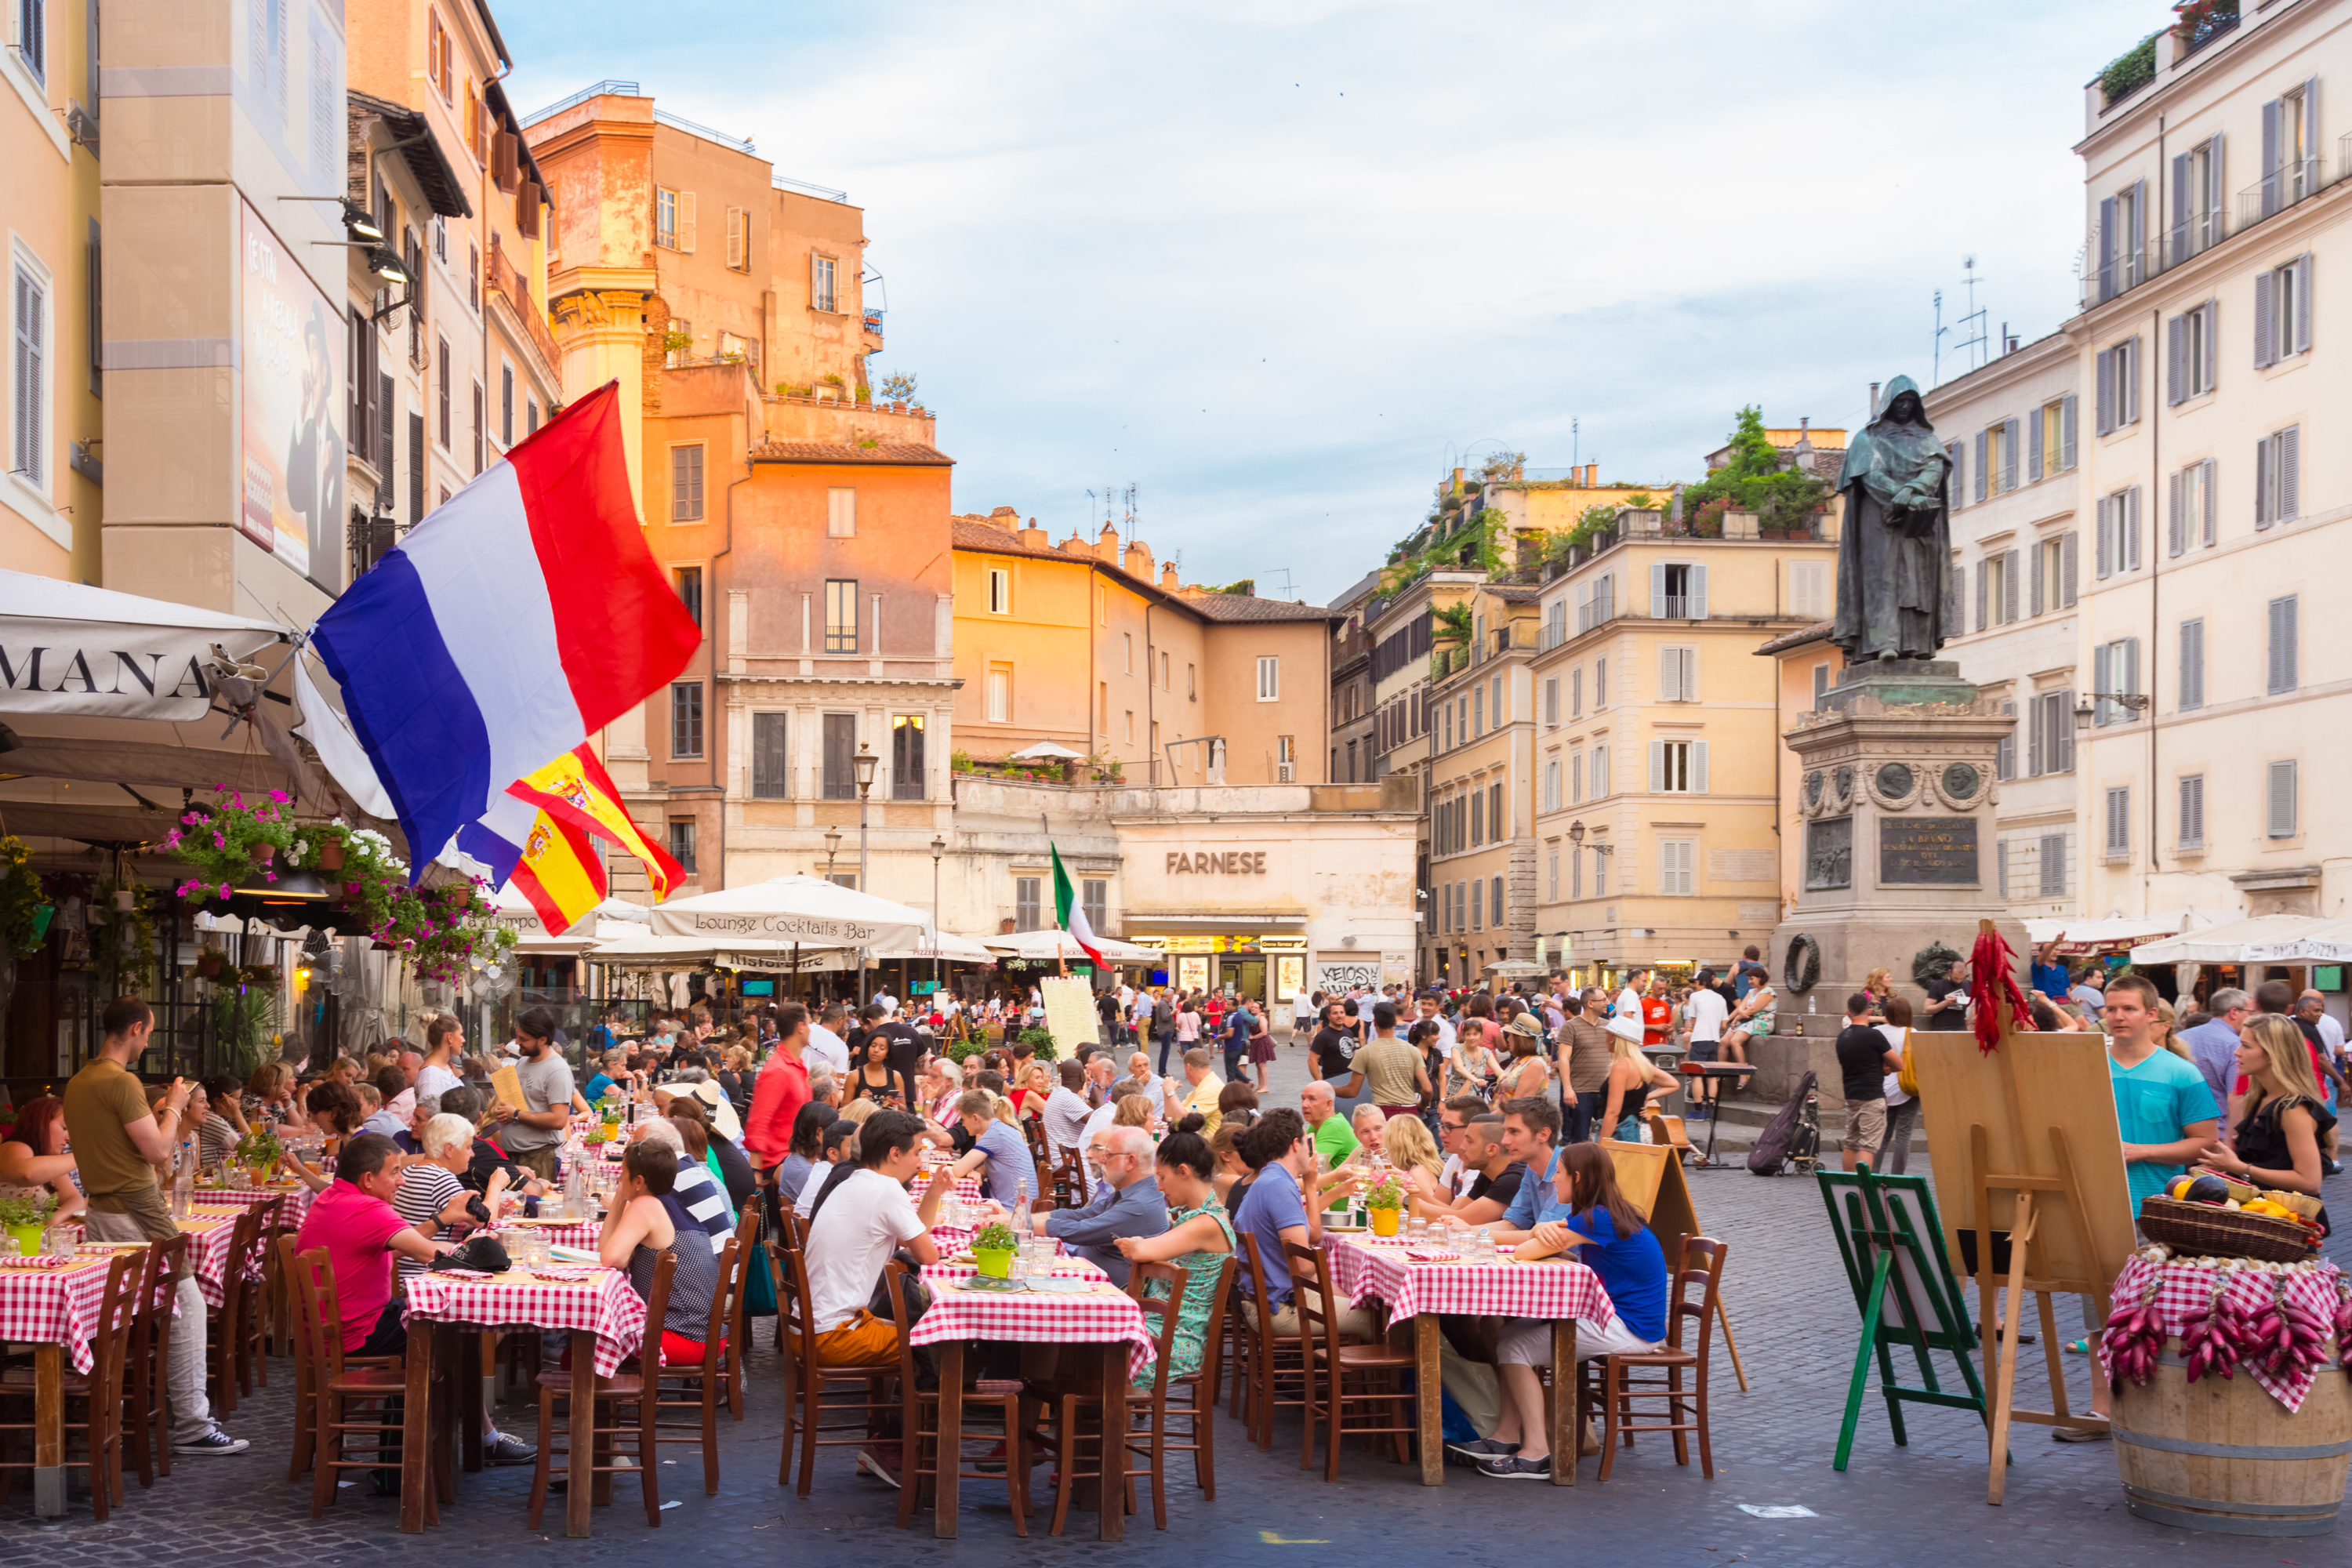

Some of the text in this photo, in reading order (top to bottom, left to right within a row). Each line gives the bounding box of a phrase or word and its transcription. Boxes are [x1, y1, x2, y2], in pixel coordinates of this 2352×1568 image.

[1166, 851, 1267, 874] FARNESE
[695, 913, 875, 940] Lounge Cocktails Bar
